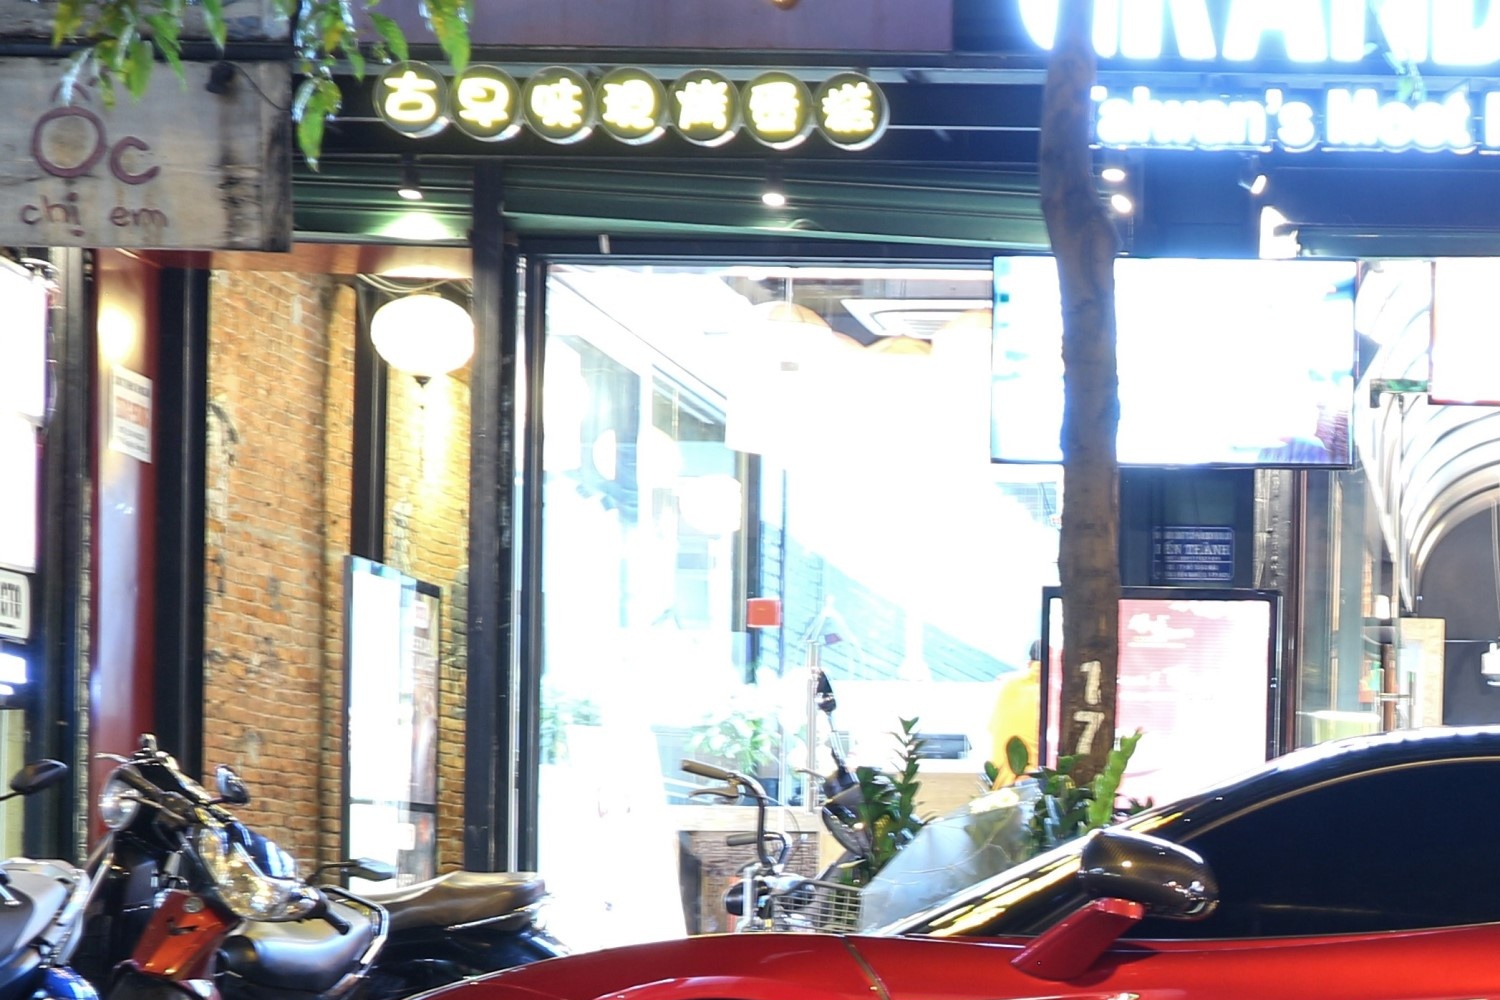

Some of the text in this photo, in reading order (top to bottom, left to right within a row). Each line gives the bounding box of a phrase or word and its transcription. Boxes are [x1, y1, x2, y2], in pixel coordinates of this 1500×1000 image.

[1089, 86, 1315, 148] aiwan's
[1325, 87, 1473, 147] Most
[19, 193, 169, 238] chị em
